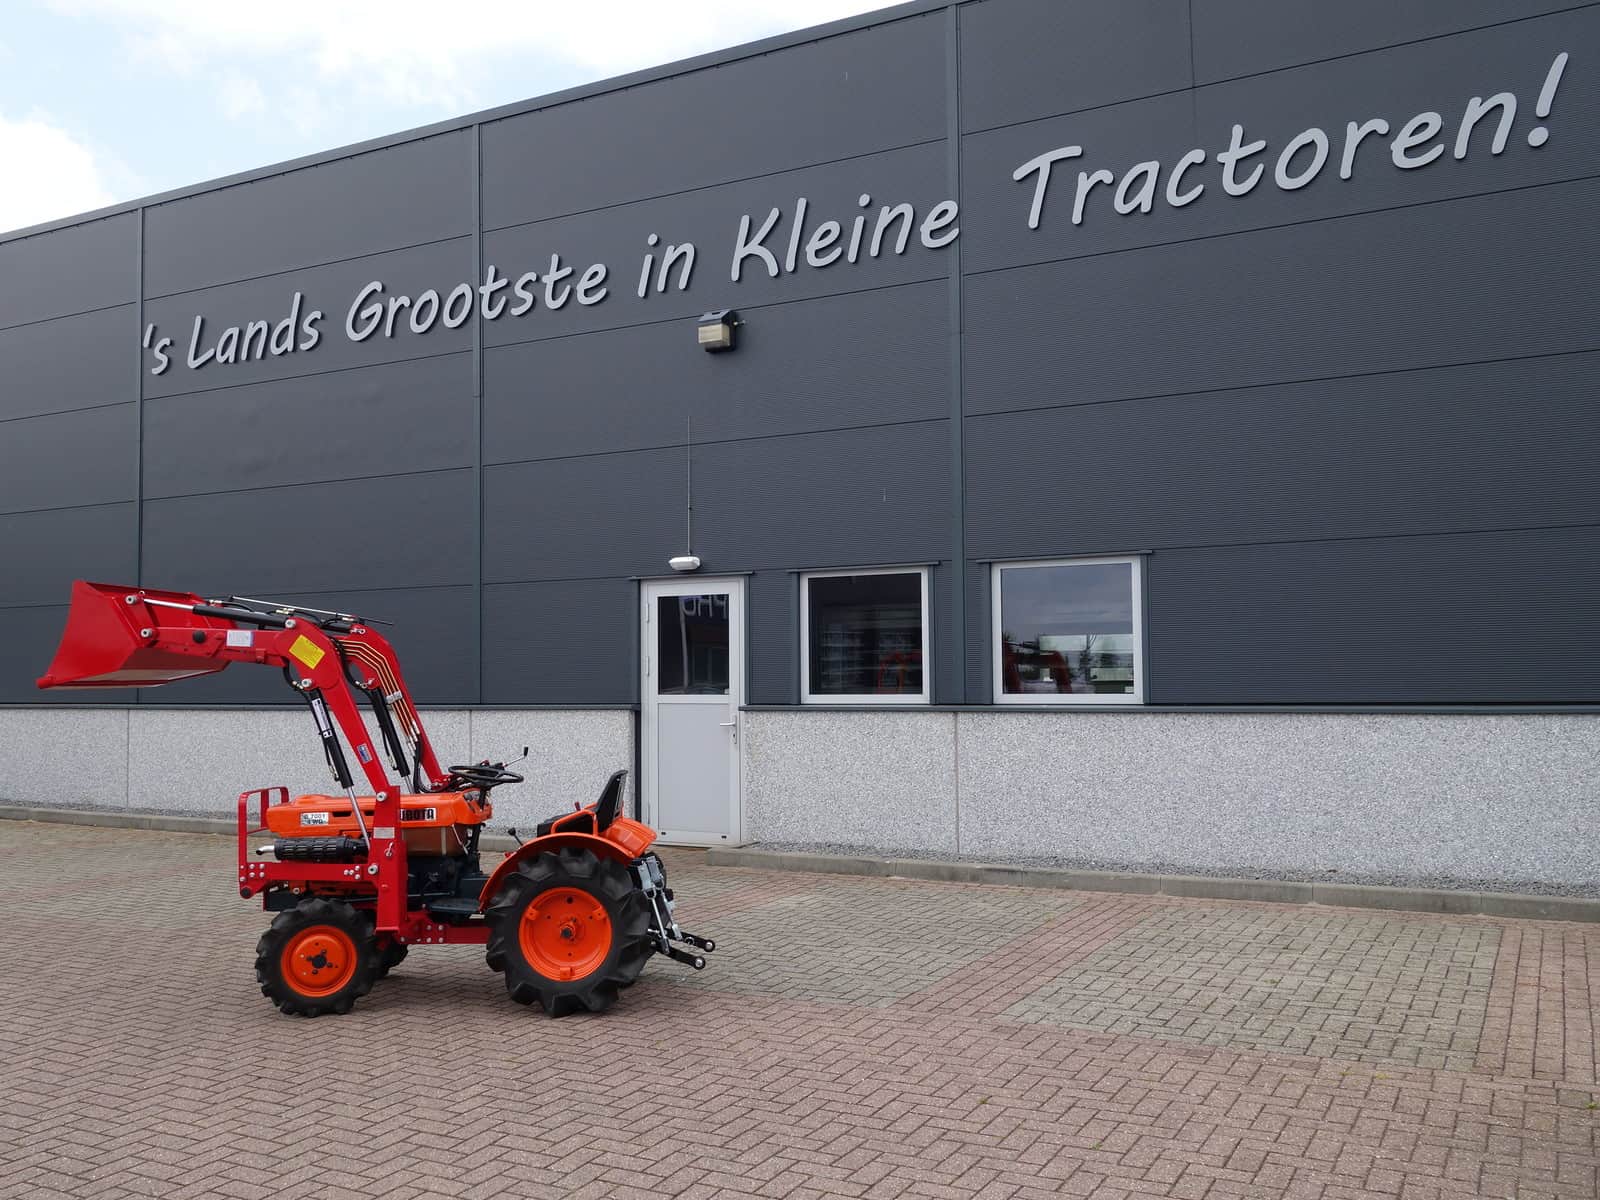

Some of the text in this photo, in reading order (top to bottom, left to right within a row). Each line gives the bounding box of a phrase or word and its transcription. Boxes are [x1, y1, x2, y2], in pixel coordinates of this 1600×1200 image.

[141, 53, 1569, 375] 's Lands Grootste in Kleine Tractoren!
